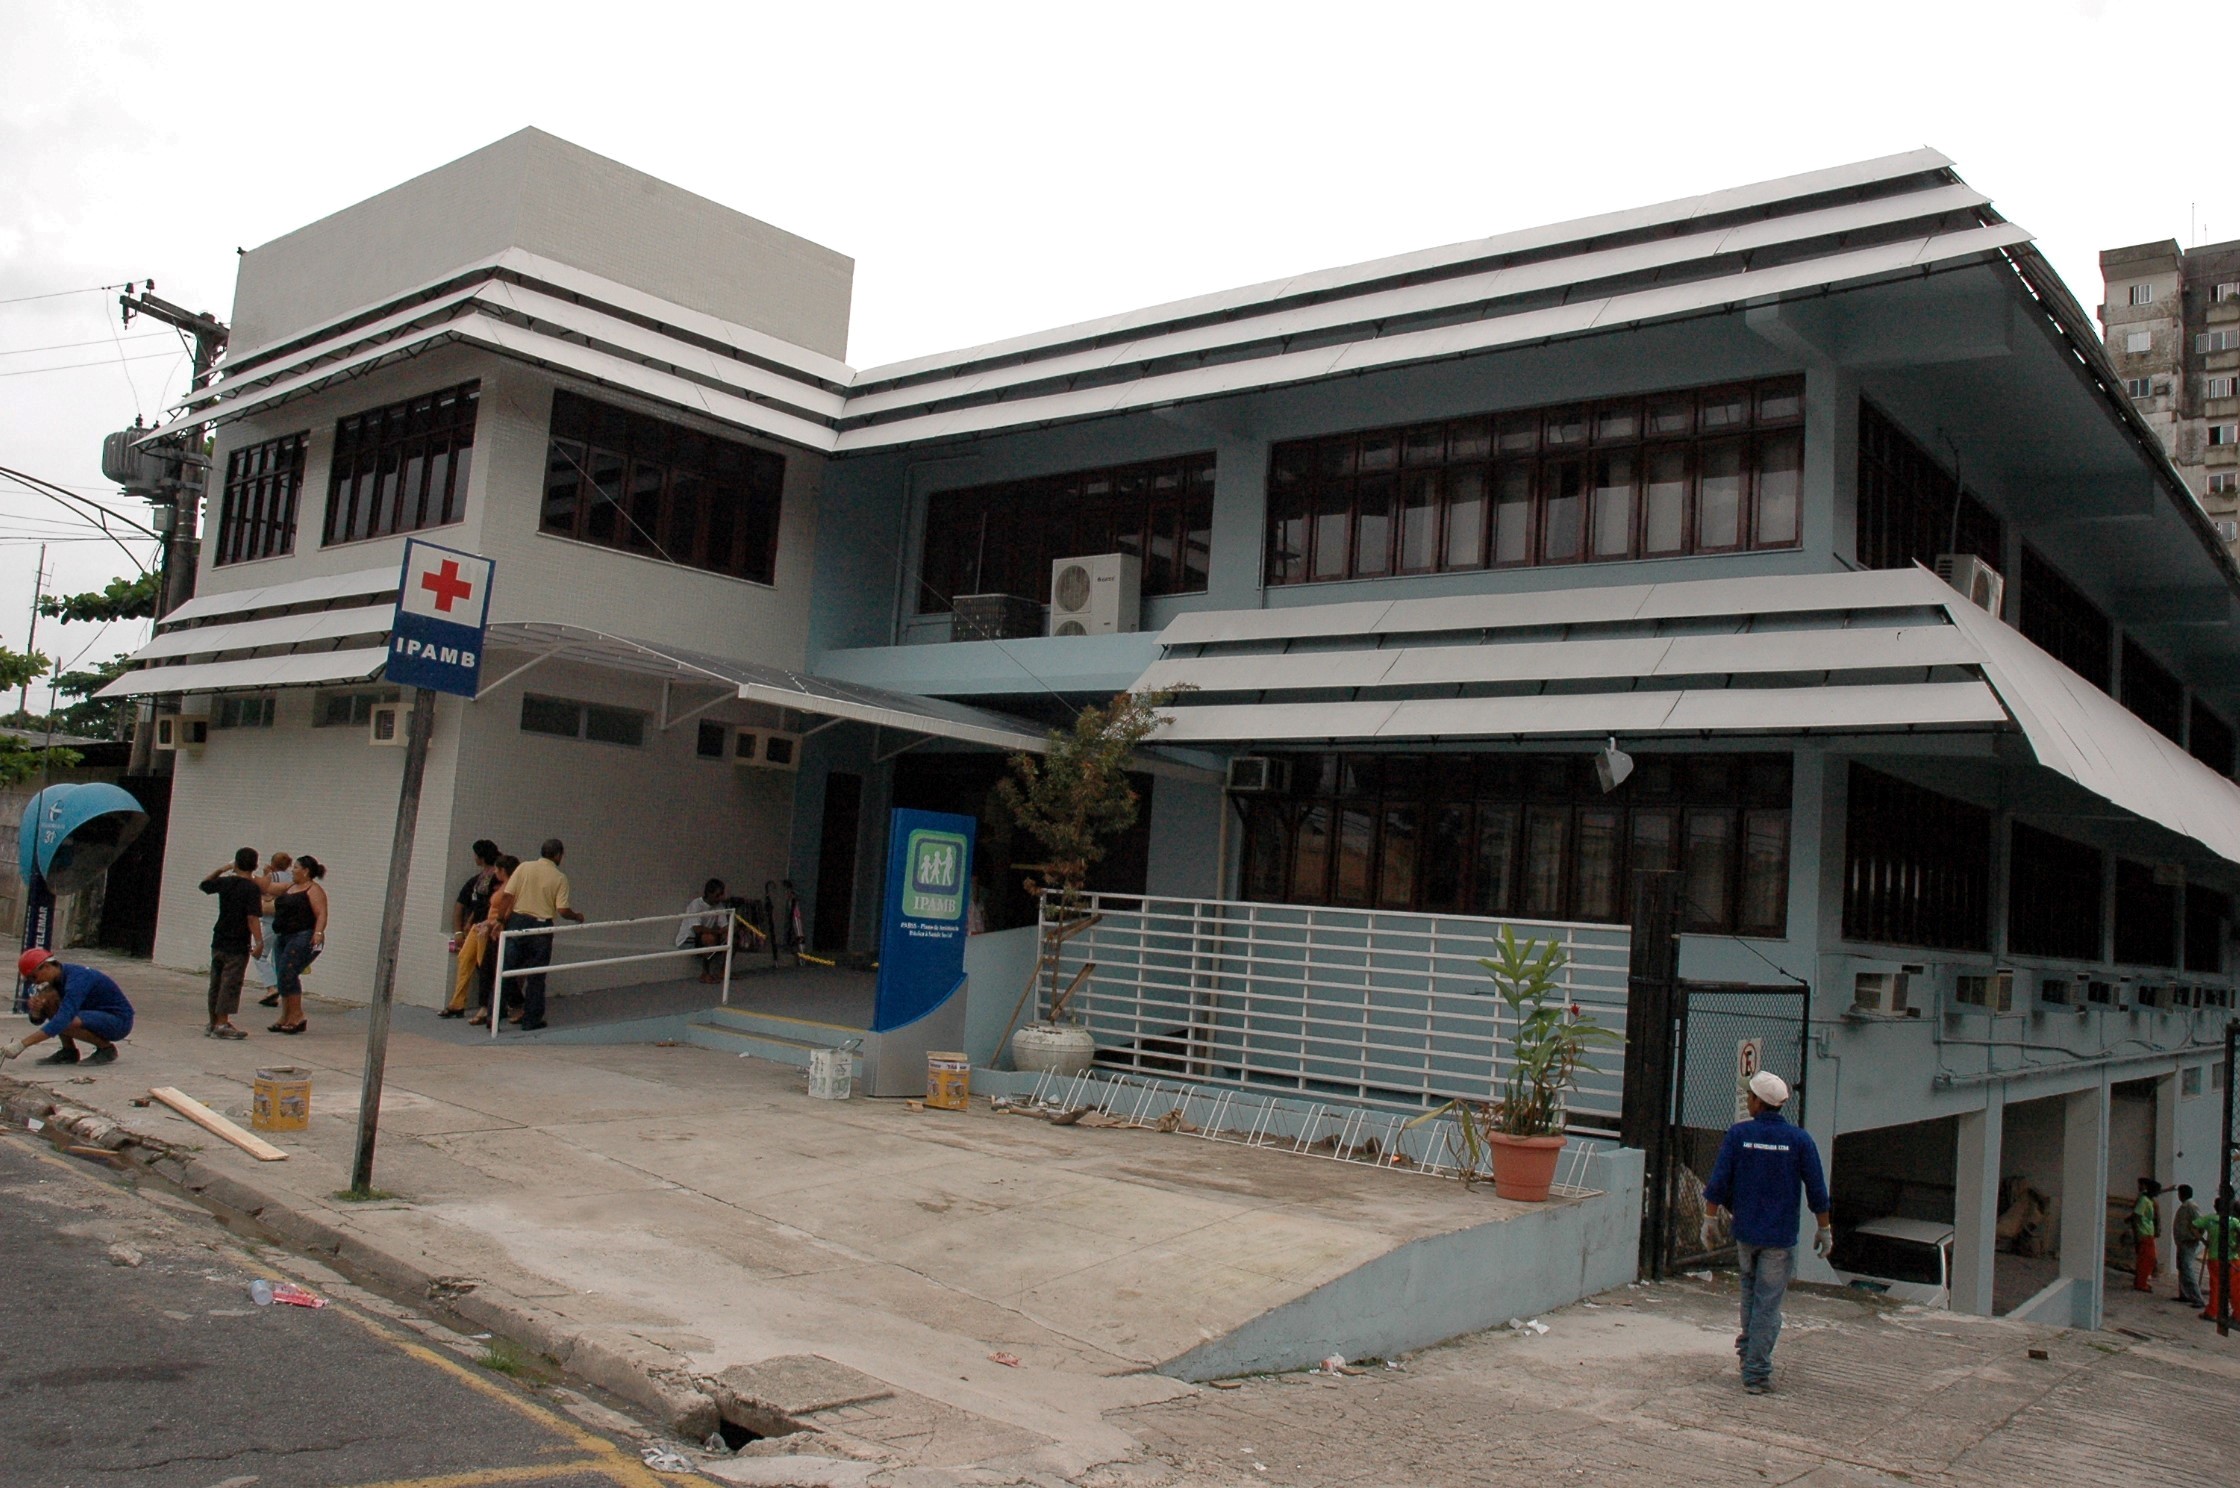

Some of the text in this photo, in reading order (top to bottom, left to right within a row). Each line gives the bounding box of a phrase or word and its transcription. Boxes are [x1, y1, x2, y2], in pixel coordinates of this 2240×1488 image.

[396, 637, 475, 668] IPAMB
[913, 896, 956, 912] IPAMB
[35, 906, 48, 949] TELEMAR
